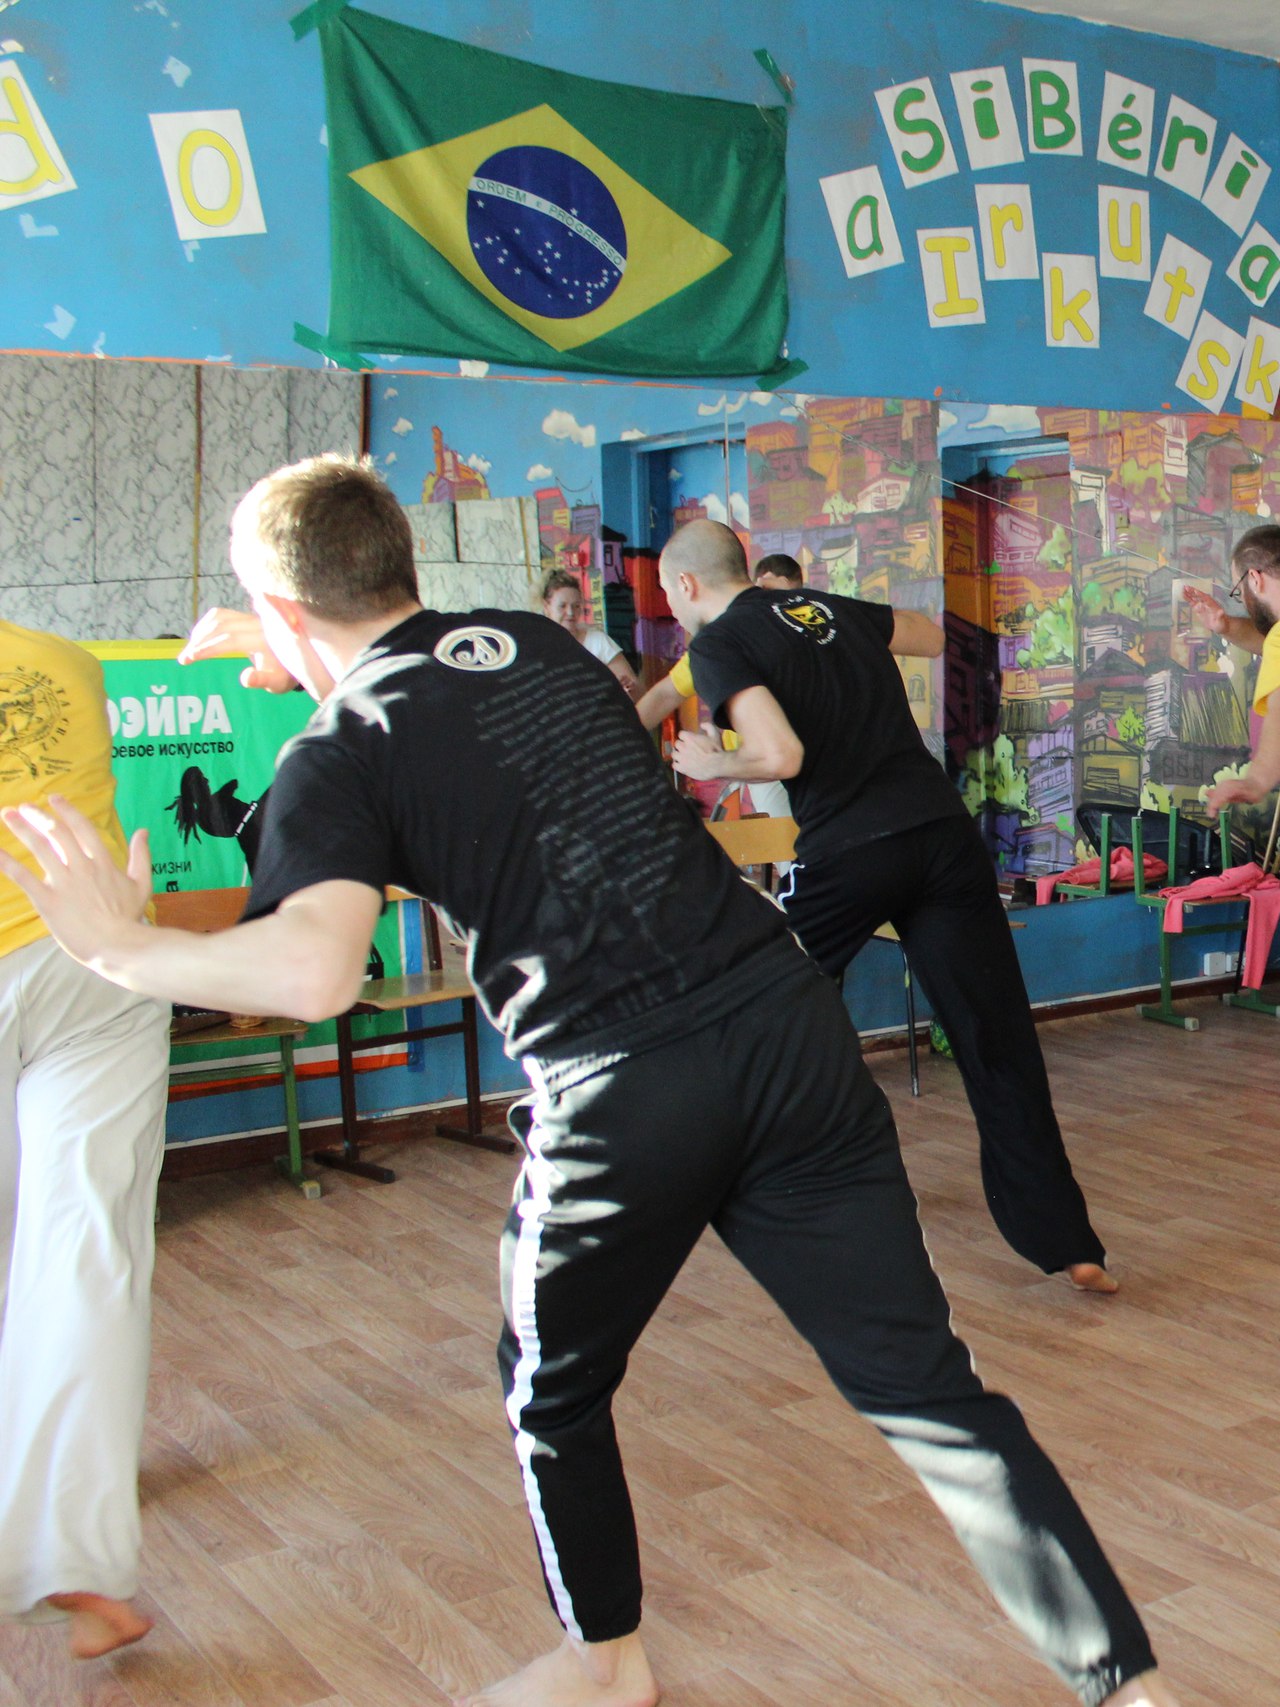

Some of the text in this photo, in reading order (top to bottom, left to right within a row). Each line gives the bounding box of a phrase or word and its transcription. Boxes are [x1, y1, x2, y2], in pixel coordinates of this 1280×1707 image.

[476, 179, 528, 204] ORDEM
[548, 204, 623, 266] PROGRESSO
[111, 741, 234, 759] оевое искусство
